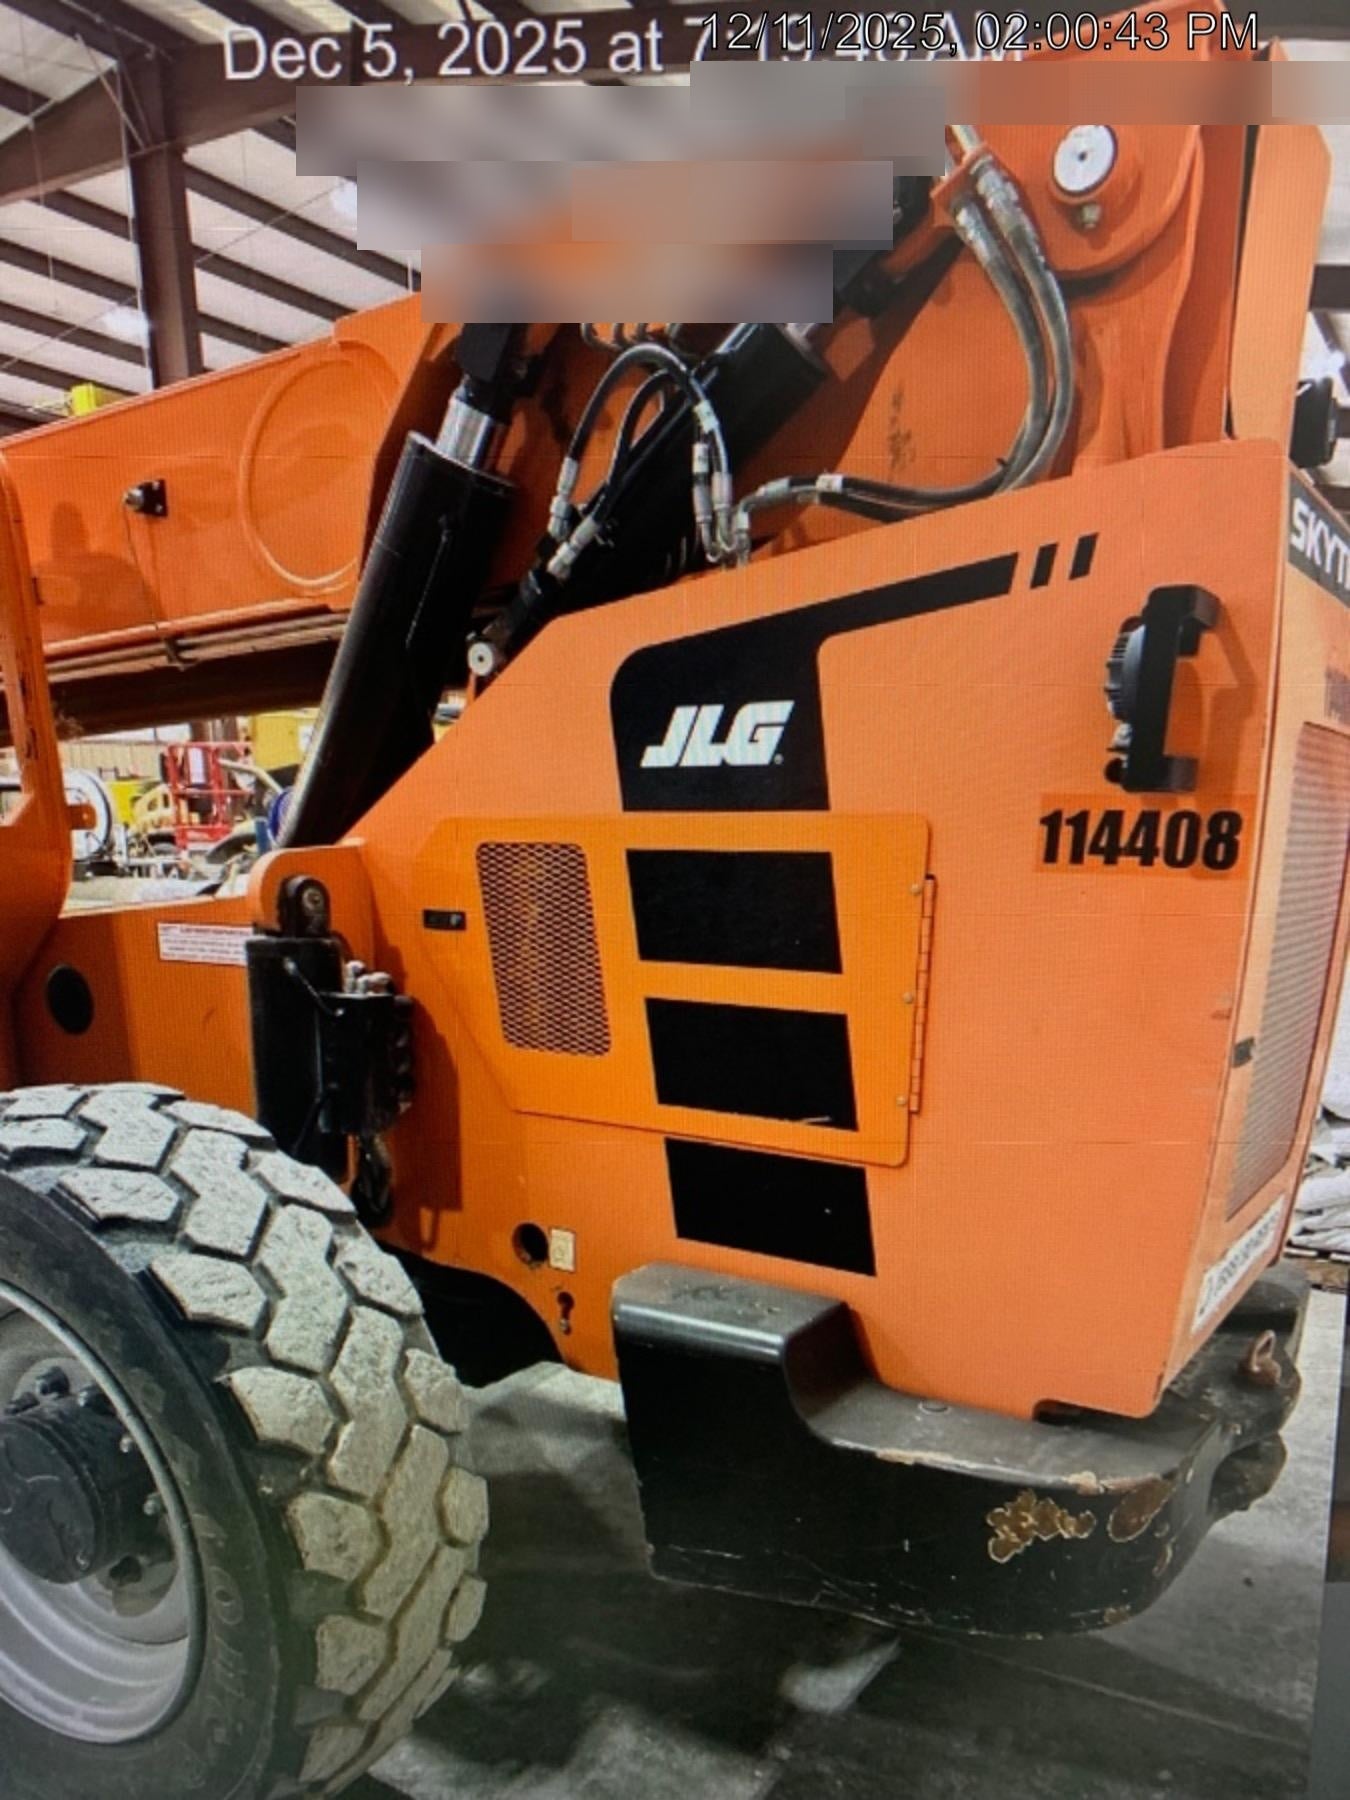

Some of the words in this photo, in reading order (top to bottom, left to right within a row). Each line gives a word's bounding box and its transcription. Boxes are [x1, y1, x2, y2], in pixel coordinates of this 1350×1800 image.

[1290, 497, 1350, 591] SKYT
[640, 700, 795, 768] JLG
[1039, 809, 1243, 871] 114408
